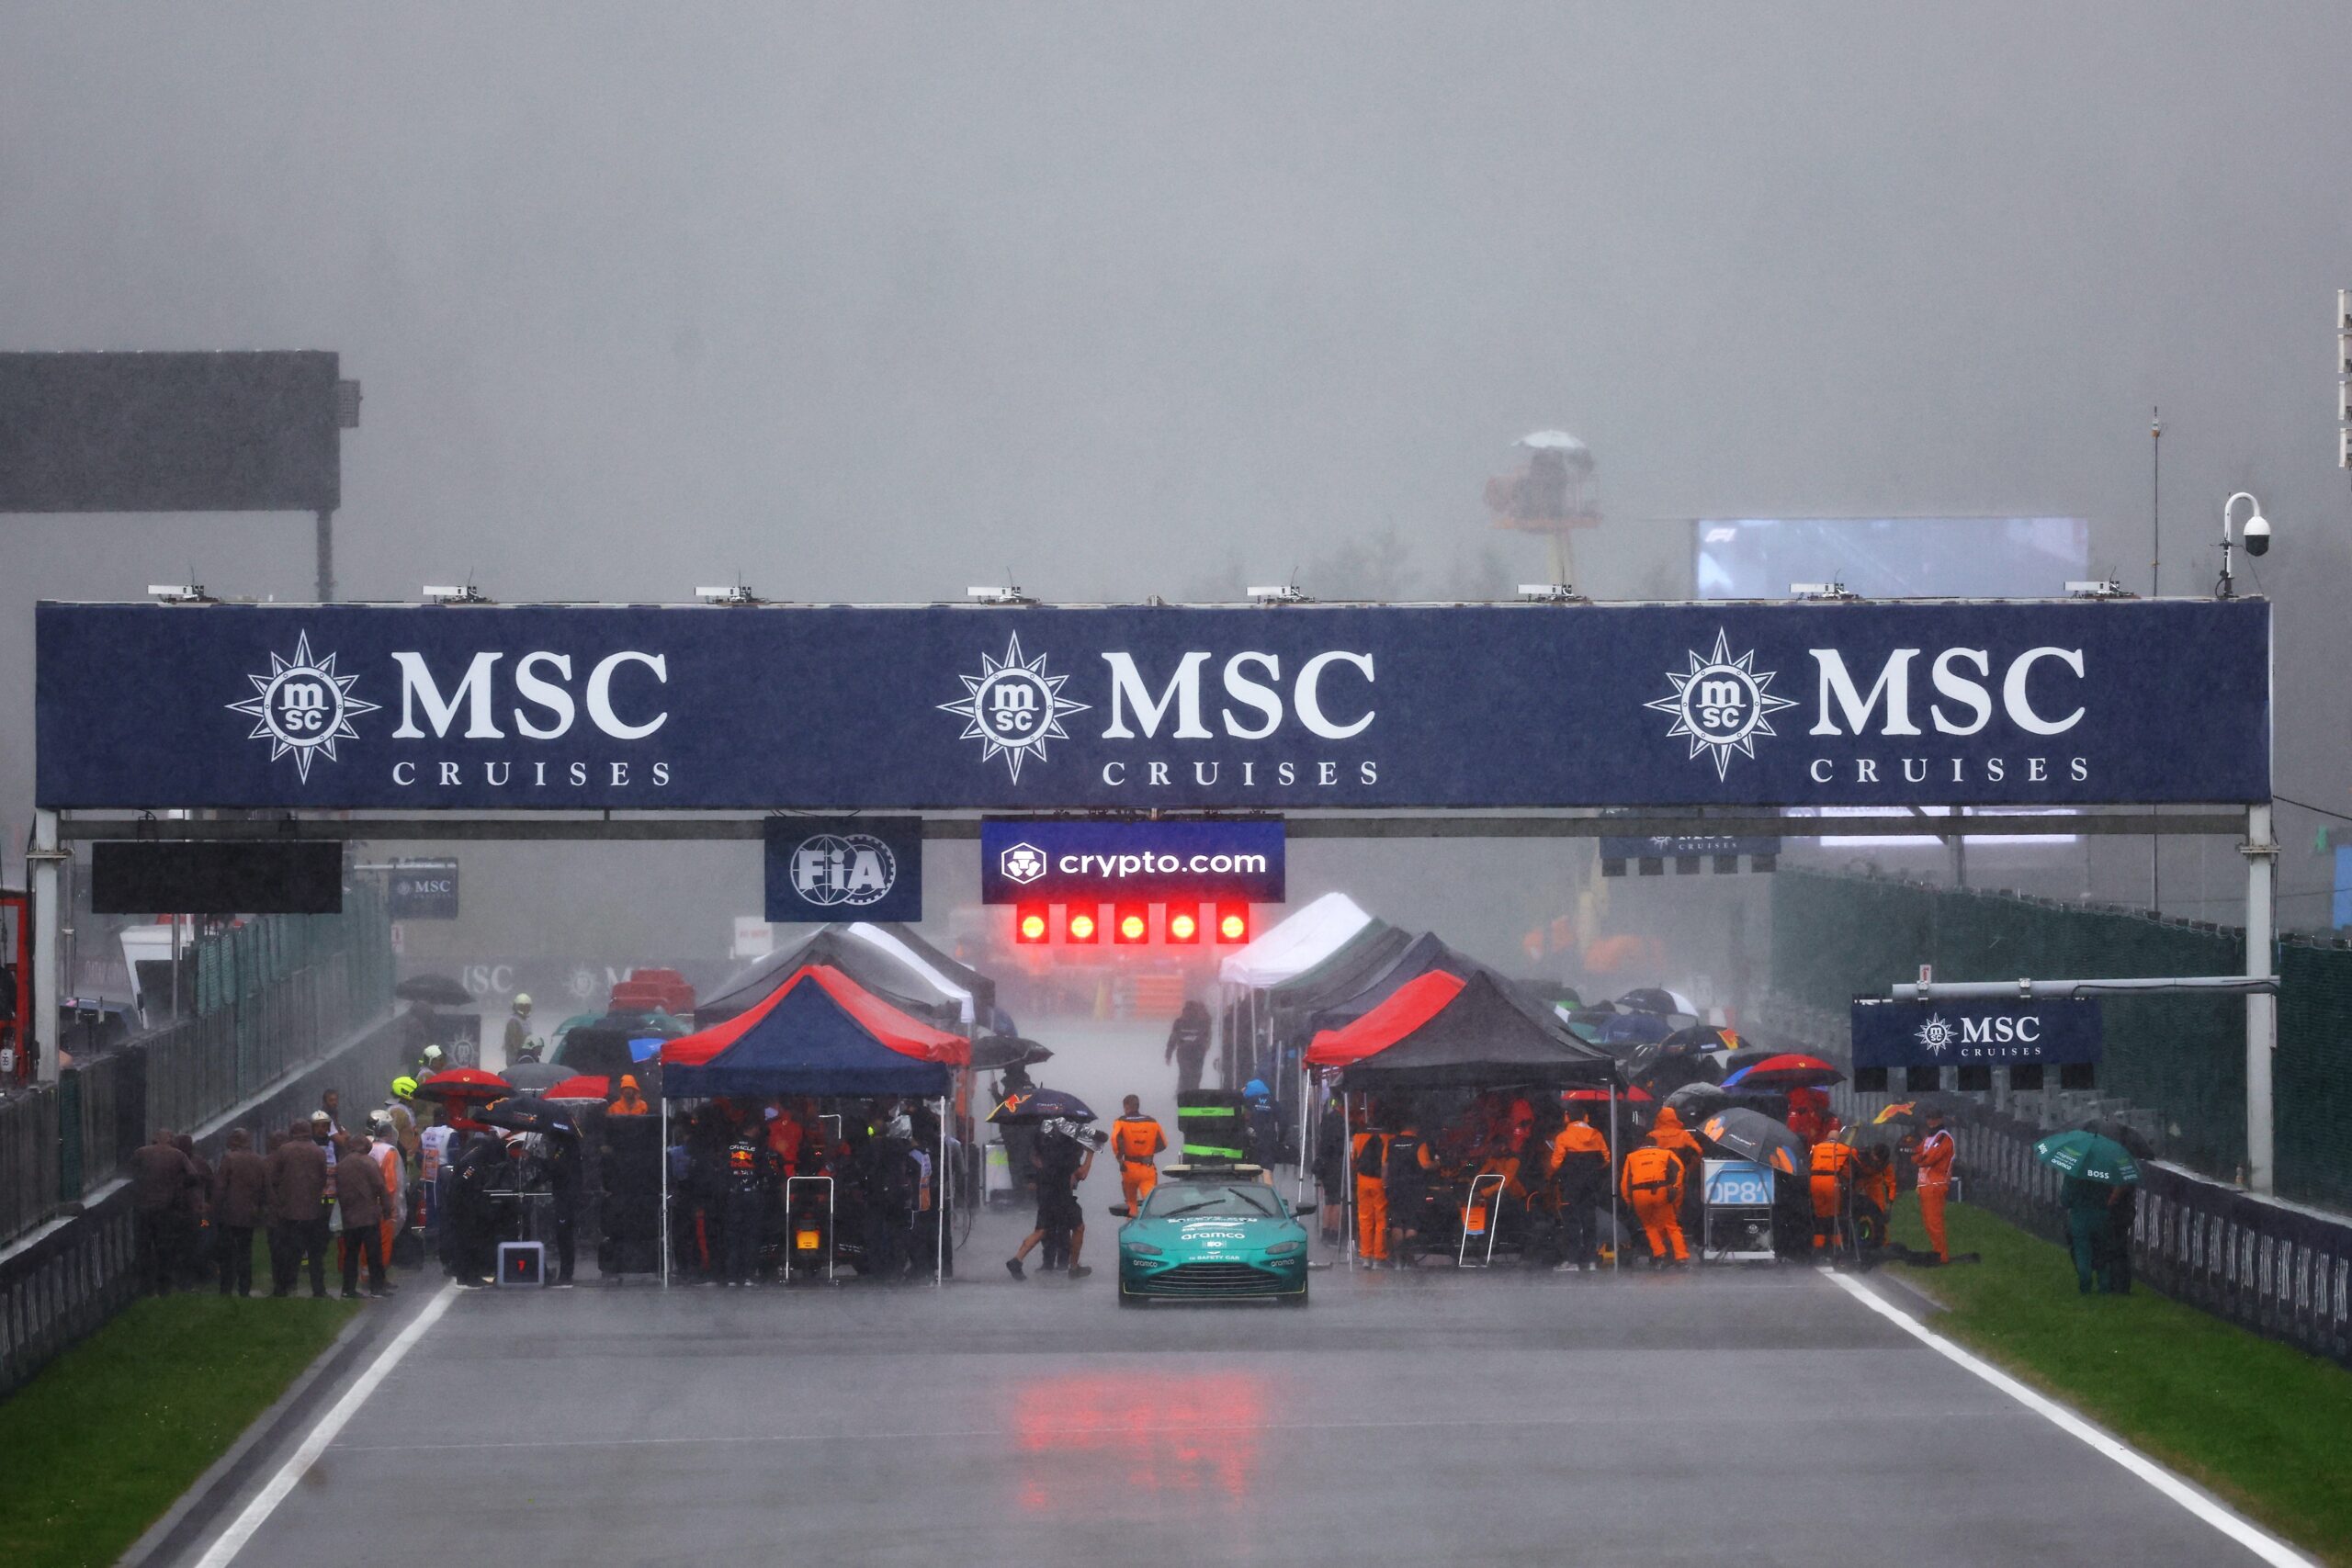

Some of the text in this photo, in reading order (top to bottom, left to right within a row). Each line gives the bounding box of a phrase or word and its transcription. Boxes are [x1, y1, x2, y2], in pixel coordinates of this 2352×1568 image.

[391, 651, 668, 739] MSC
[1101, 651, 1375, 739] MSC
[1808, 647, 2085, 736] MSC
[393, 761, 670, 786] CRUISES
[1103, 761, 1377, 786] CRUISES
[1811, 757, 2087, 783] CRUISES
[1679, 840, 1737, 851] CRUISES
[1059, 851, 1266, 878] crypto.com
[415, 880, 451, 893] MSC
[463, 965, 514, 993] SC
[1961, 1016, 2041, 1043] MSC
[1961, 1047, 2041, 1056] CRUISES
[2087, 1169, 2110, 1180] BOSS
[1181, 1232, 1246, 1241] aramco
[1133, 1259, 1159, 1269] aramco
[1271, 1258, 1295, 1268] aramco
